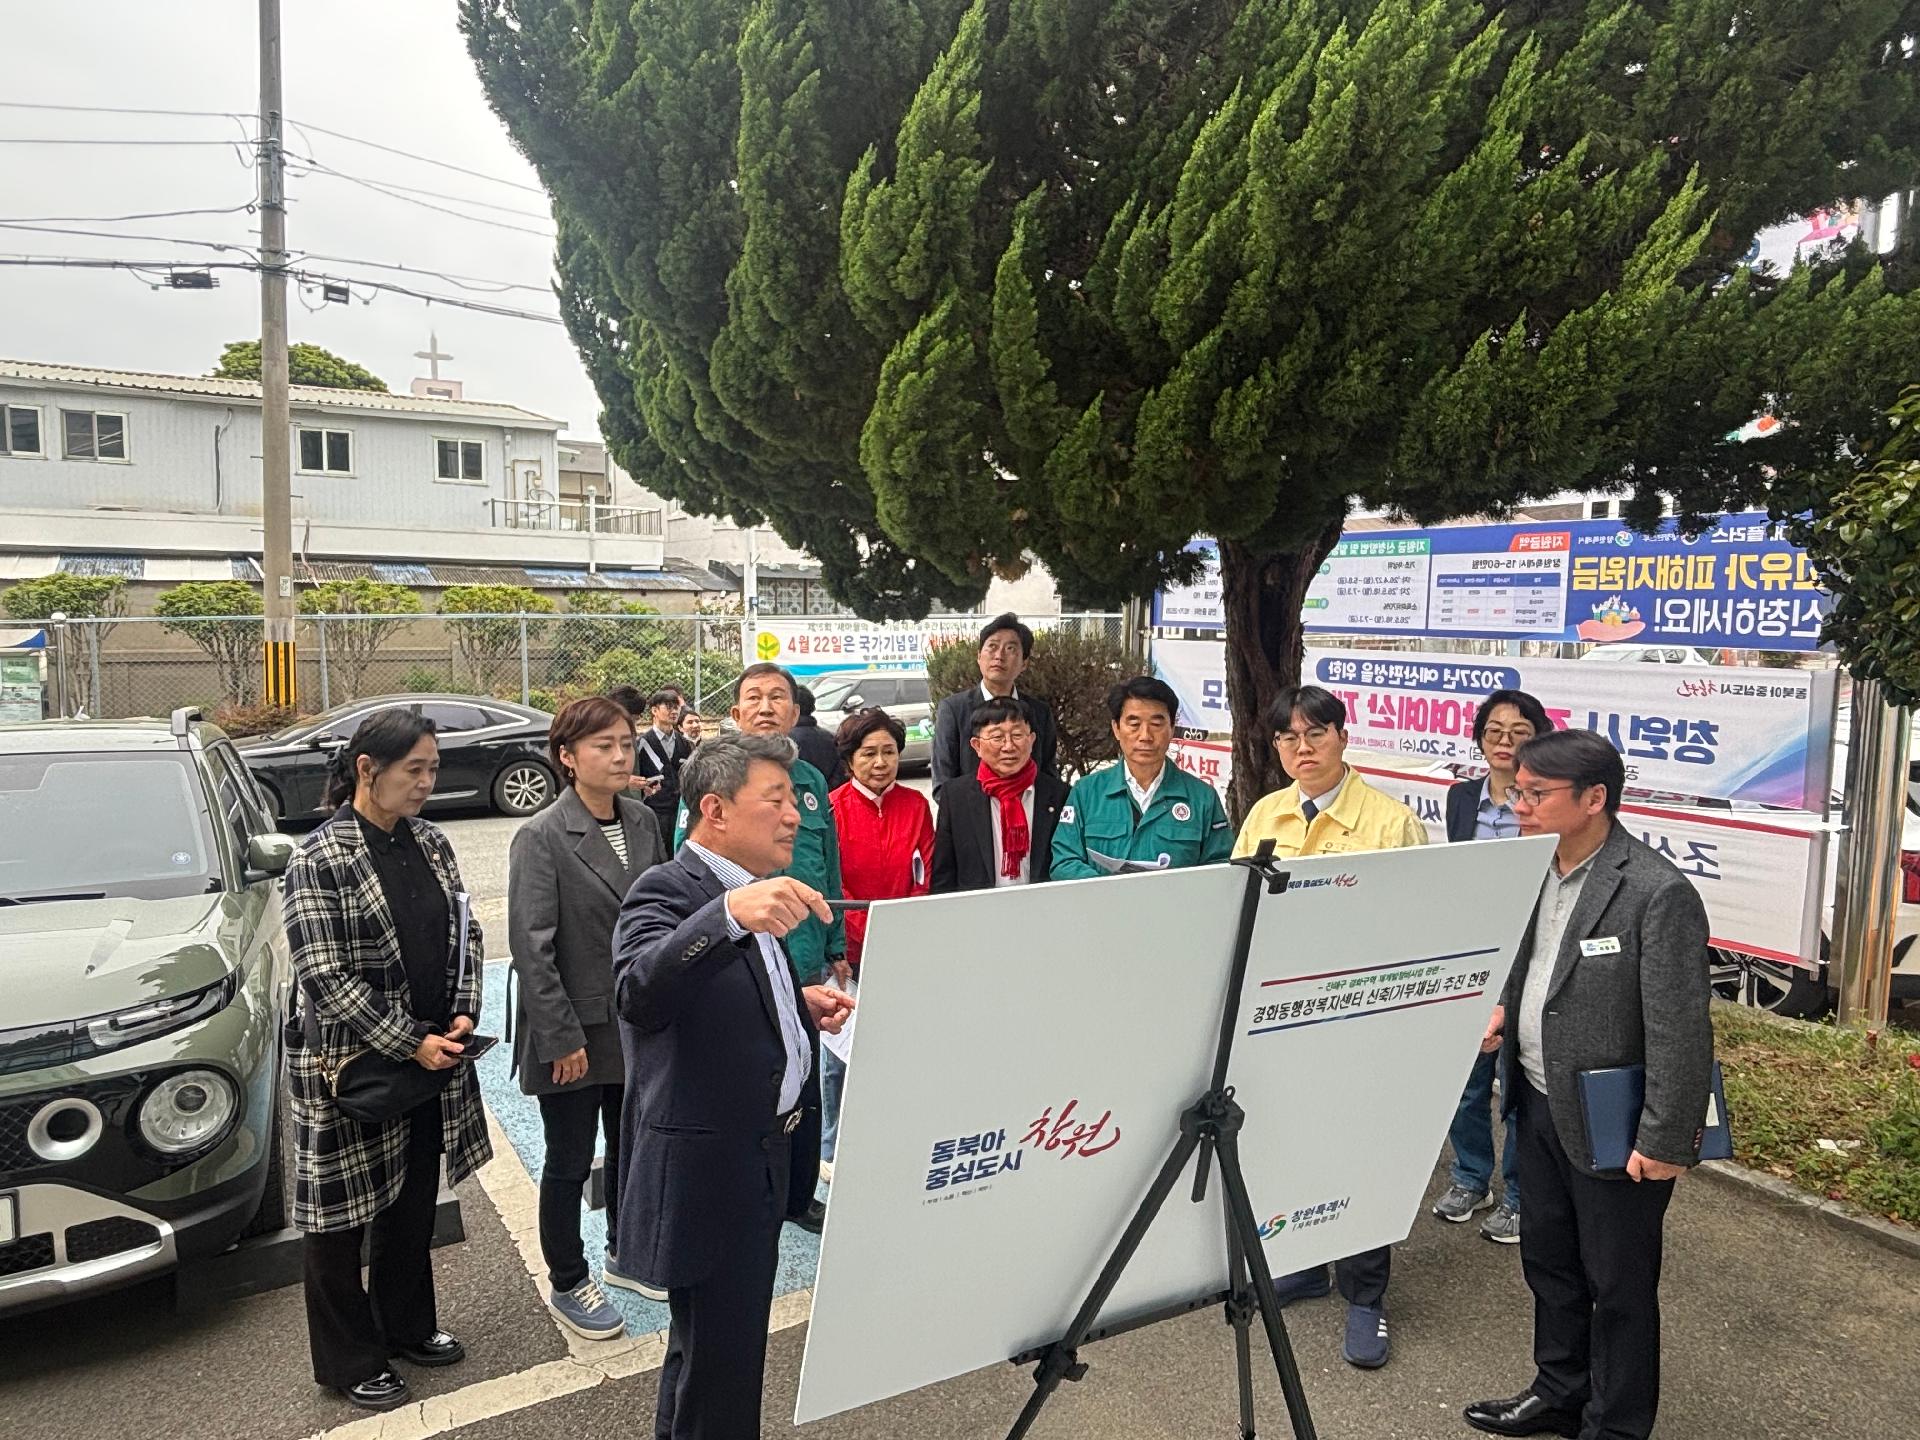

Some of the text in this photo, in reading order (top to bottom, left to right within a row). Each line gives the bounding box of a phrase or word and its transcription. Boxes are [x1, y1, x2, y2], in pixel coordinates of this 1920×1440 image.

[787, 634, 810, 654] 4월
[813, 634, 856, 654] 22일은
[859, 634, 919, 653] 국가기념일
[1251, 989, 1365, 1025] 경화동행정복지센터
[1442, 973, 1467, 991] 추진
[1466, 968, 1492, 989] 현황
[930, 1127, 1006, 1165] 동북아
[1018, 1098, 1121, 1162] 창원
[924, 1148, 1023, 1192] 중심도시
[1290, 1195, 1351, 1223] 창원특례시
